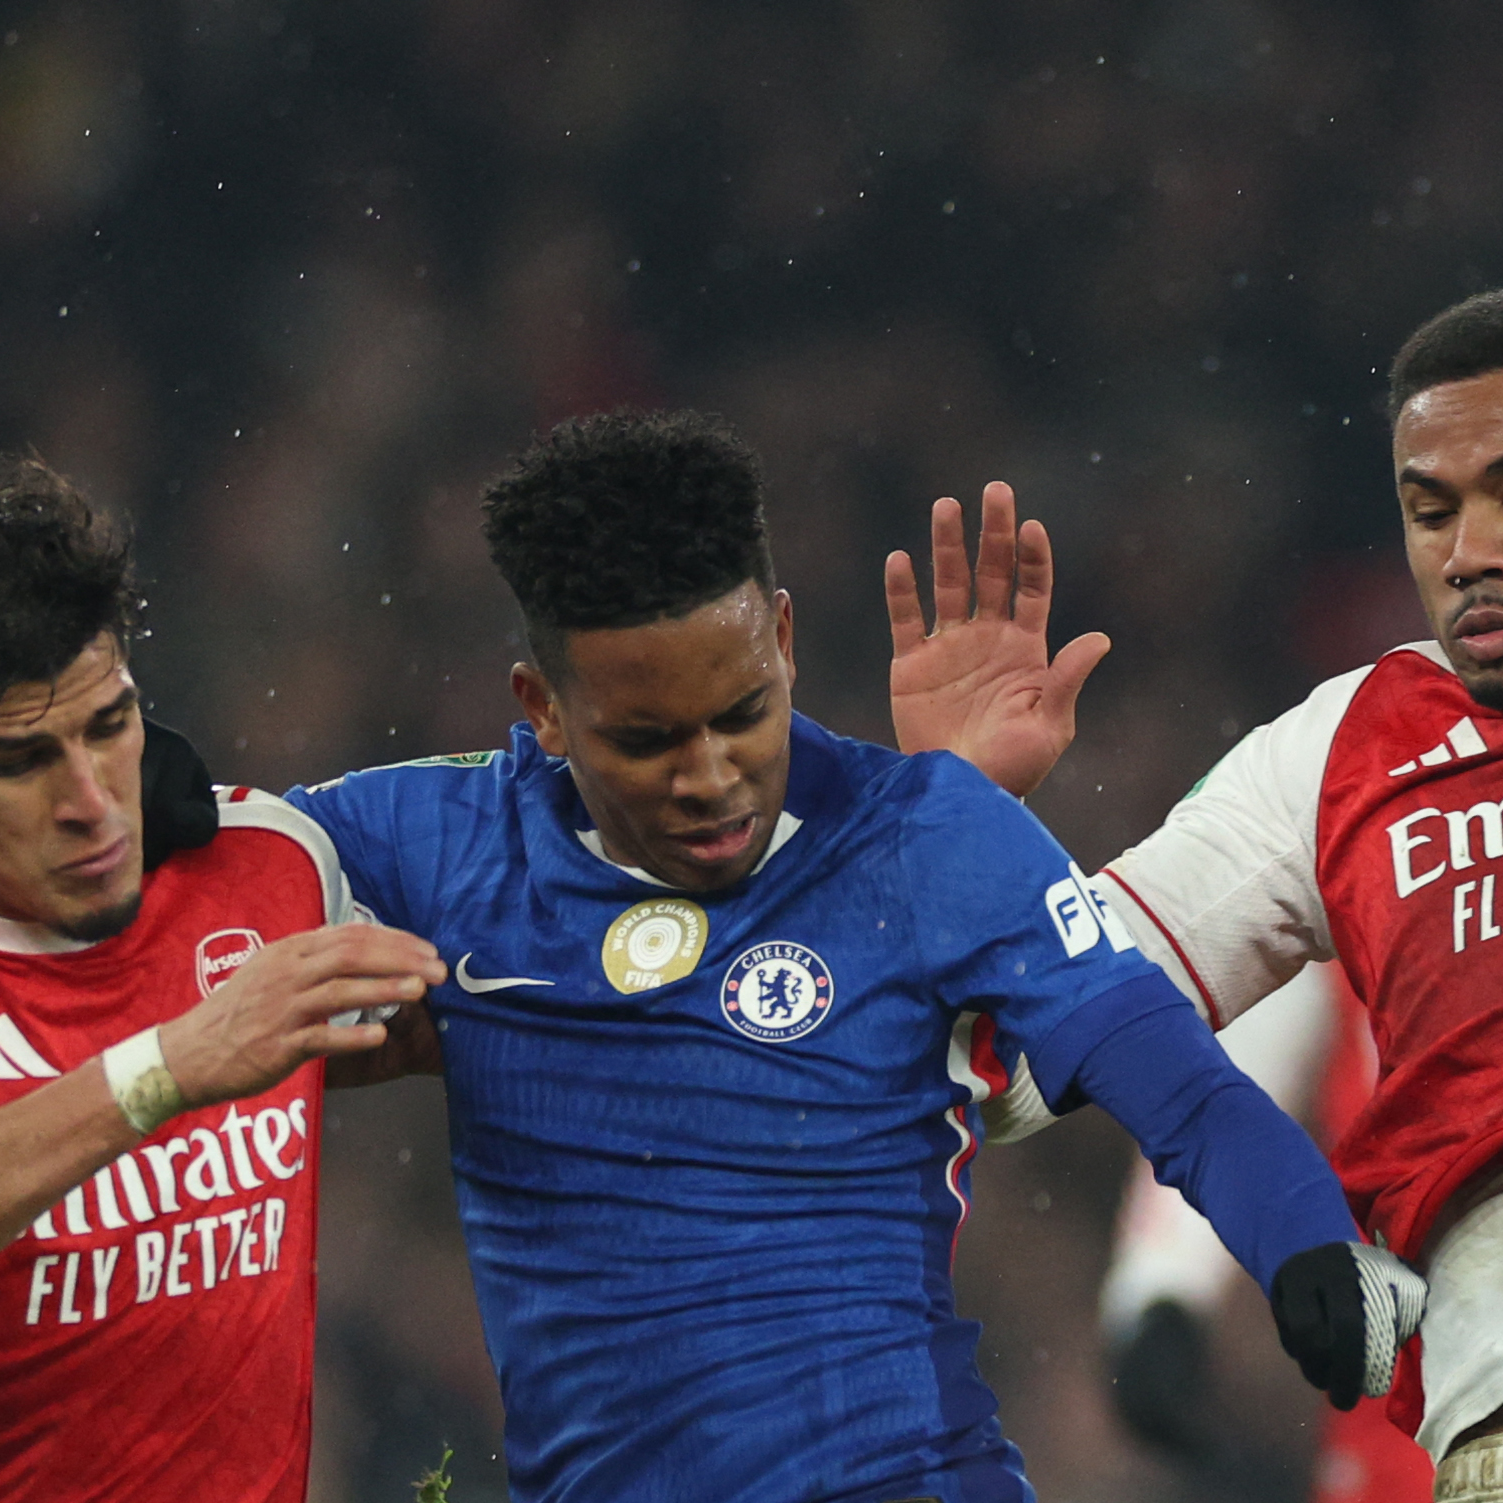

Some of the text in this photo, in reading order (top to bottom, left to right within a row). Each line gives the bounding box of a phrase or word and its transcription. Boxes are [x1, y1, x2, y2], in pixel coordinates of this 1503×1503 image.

[612, 904, 699, 958] WORLD CHAMPIONS
[741, 946, 813, 969] CHELSEA
[623, 970, 662, 989] FIFA
[739, 1018, 814, 1037] FOOTBALL CLUB
[26, 1198, 286, 1326] FLY BETTER
